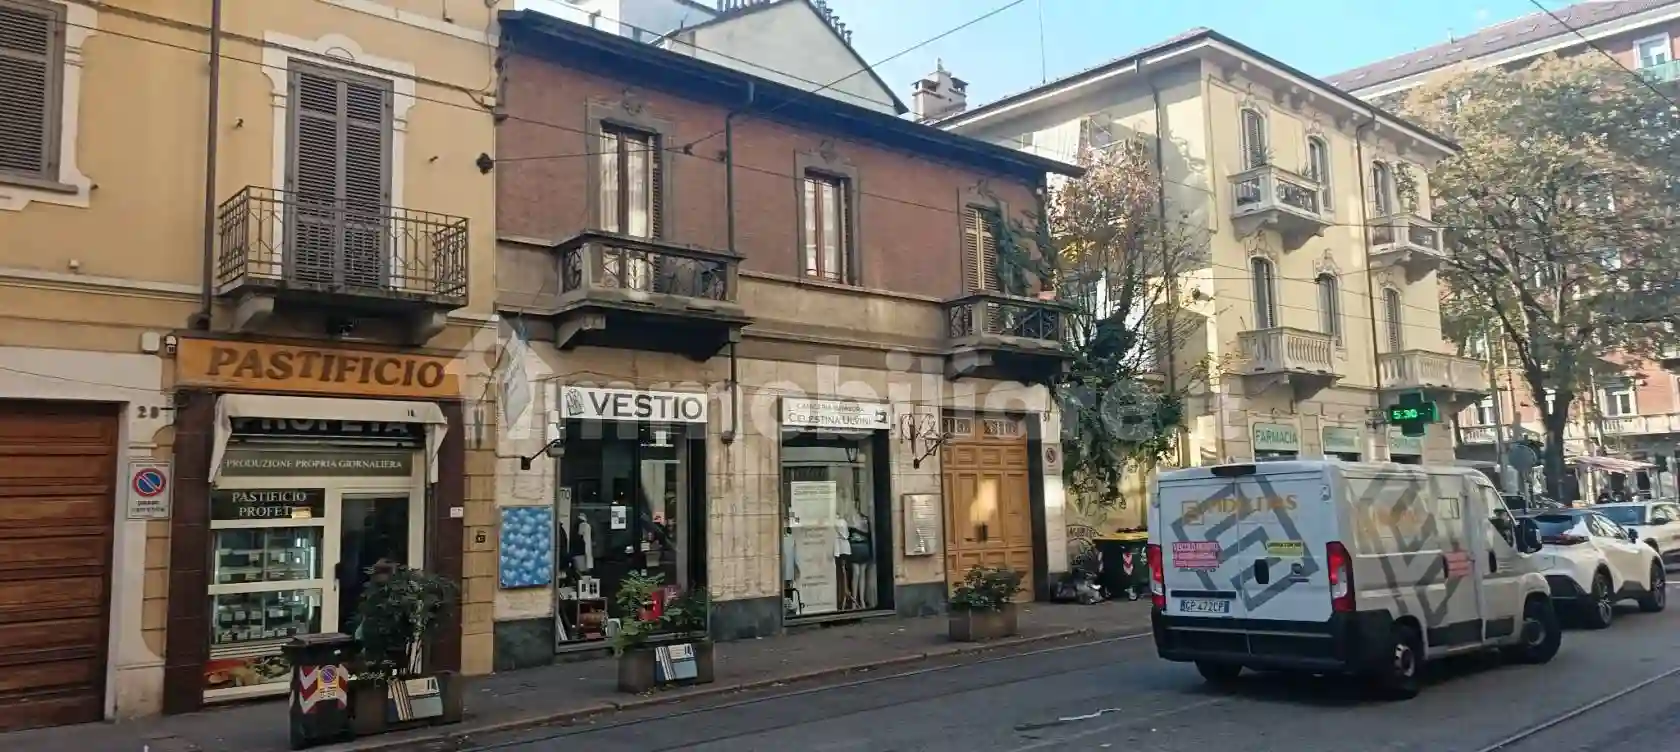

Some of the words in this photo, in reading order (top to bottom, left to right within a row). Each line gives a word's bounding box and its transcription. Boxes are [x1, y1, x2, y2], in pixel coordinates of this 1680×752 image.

[205, 346, 446, 388] PASTIFICIO
[587, 391, 703, 420] VESTIO
[1255, 429, 1298, 445] FARMACIA
[226, 459, 293, 468] PRODUZIONE
[295, 459, 337, 468] PROPRIA
[338, 460, 402, 469] GIORNALIERA
[232, 492, 307, 503] PASTIFICIO
[239, 506, 295, 517] PROFET
